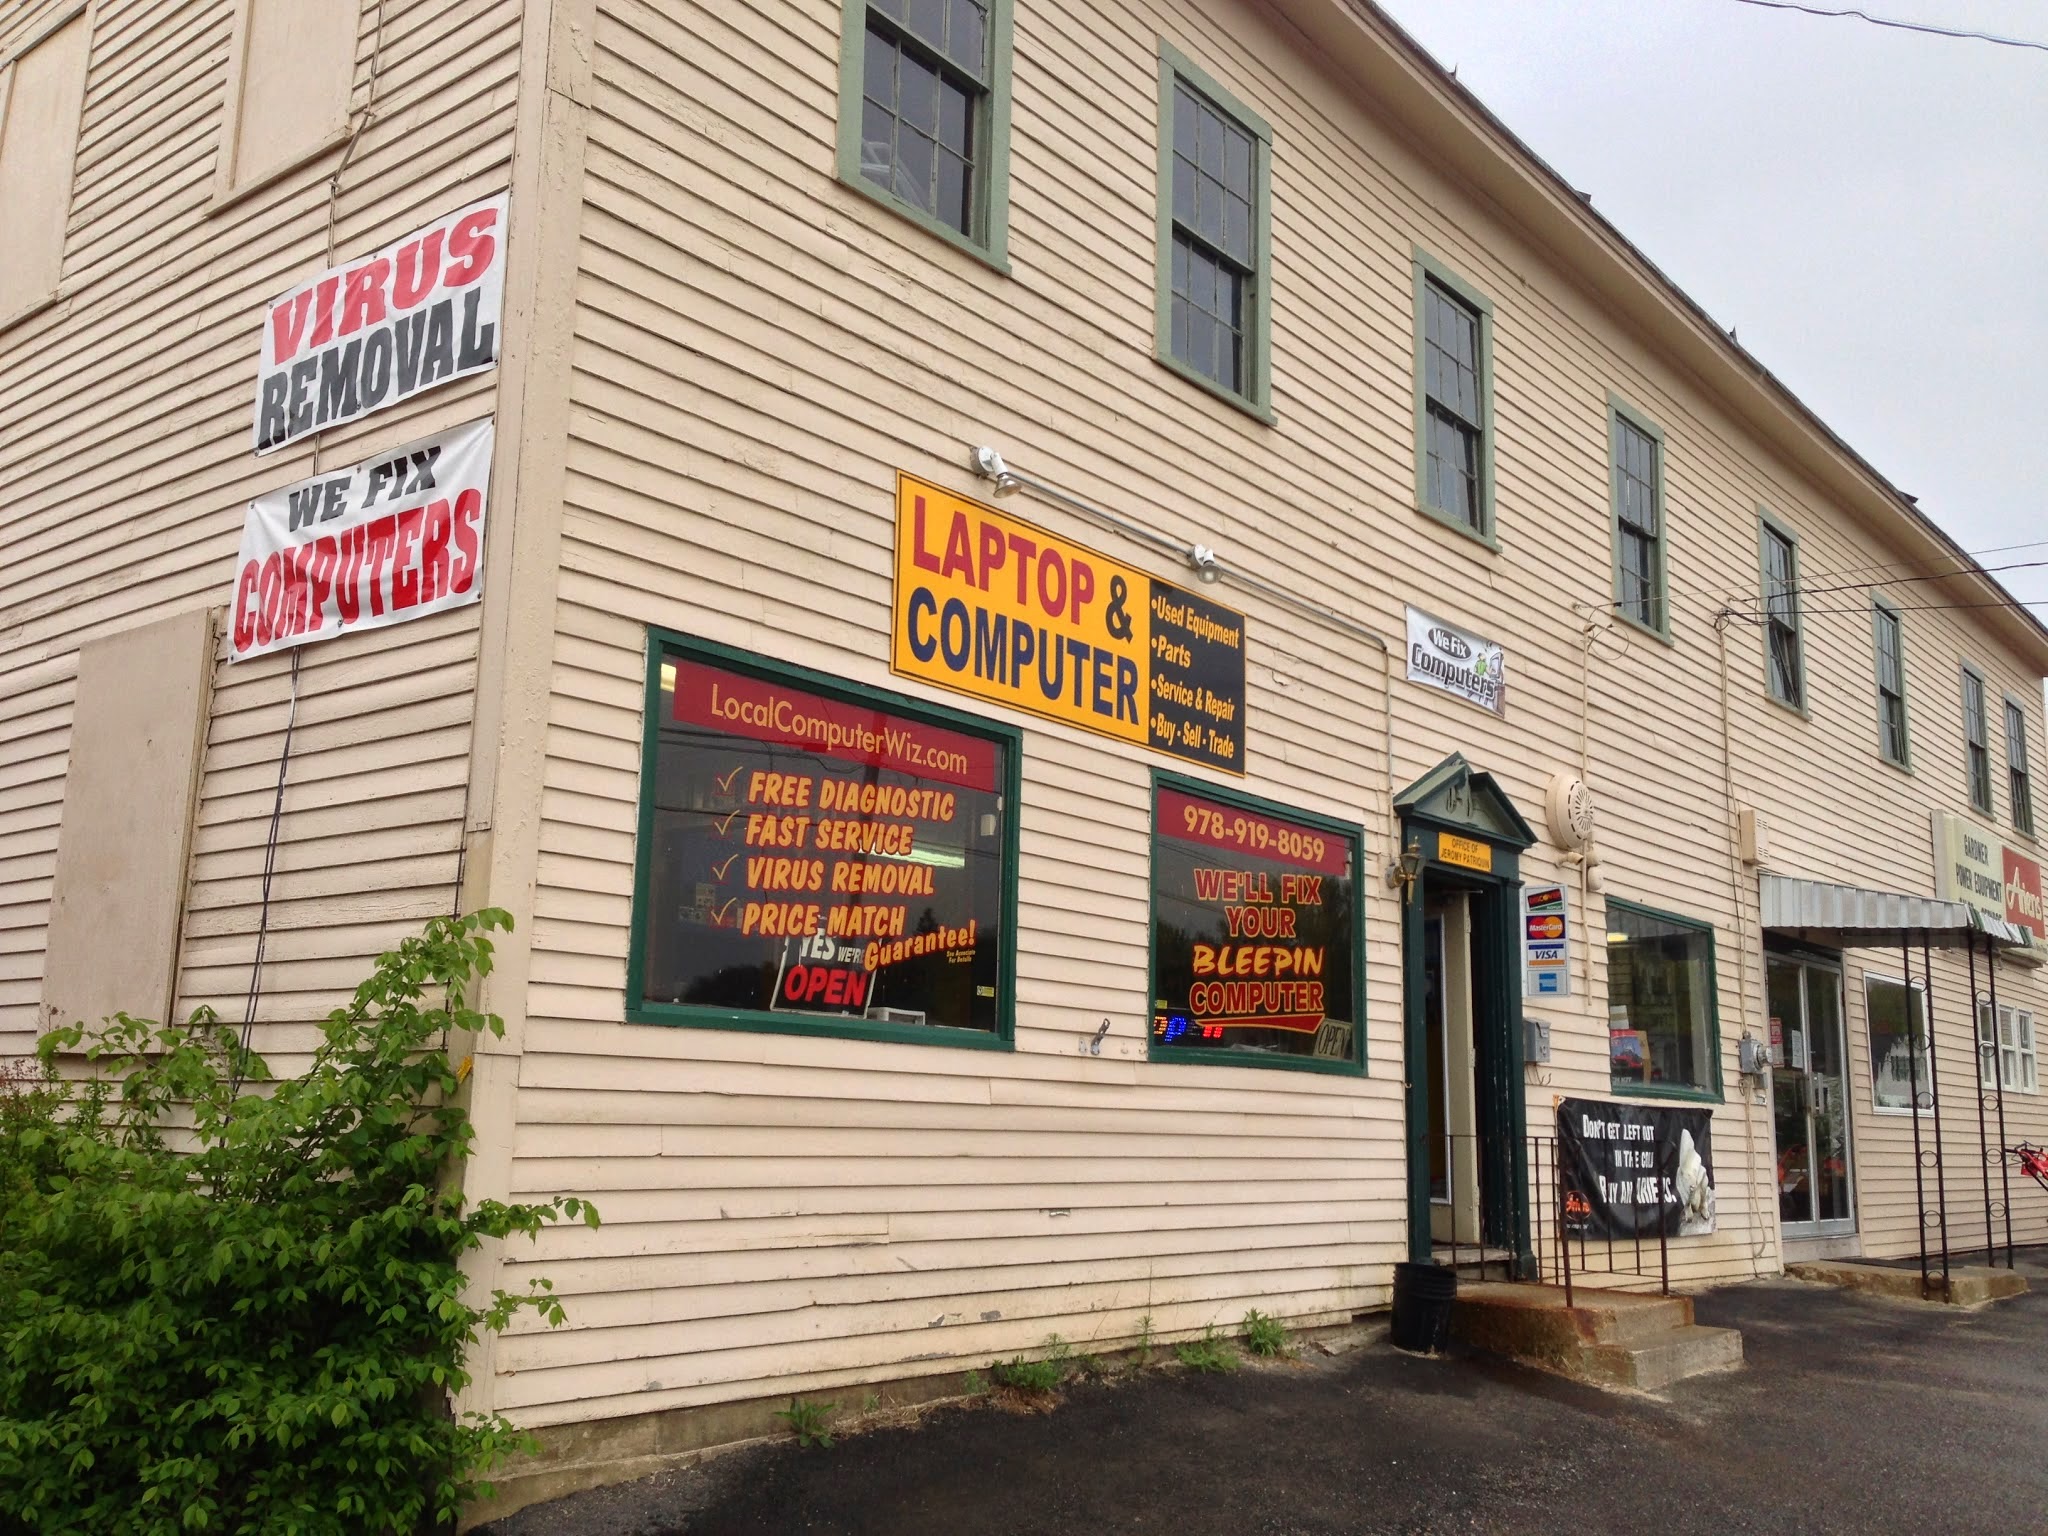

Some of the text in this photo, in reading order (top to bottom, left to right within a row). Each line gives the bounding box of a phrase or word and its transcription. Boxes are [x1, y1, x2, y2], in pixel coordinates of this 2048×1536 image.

[271, 207, 498, 366] VIRUS
[257, 286, 495, 451] REMOVAL
[289, 446, 442, 533] WE FIX
[233, 488, 482, 653] COMPUTERS
[913, 495, 1133, 643] LAPTOP &
[1156, 595, 1240, 649] Used Equipment
[908, 587, 1139, 725] COMPUTER
[1157, 635, 1192, 668] Parts
[1433, 628, 1467, 658] We Fix
[1412, 642, 1495, 698] Computers
[1156, 673, 1235, 722] Service & Repair
[711, 683, 968, 775] LocalComputerWiz.com
[1156, 712, 1176, 746] Buy
[1183, 721, 1201, 749] Sell
[1209, 729, 1235, 759] Trade
[748, 771, 956, 823] FREE DIAGNOSTIC
[744, 814, 915, 855] FAST SERVICE
[1183, 804, 1325, 863] 978-919-8059
[1451, 838, 1479, 853] OFFICE OF
[1964, 834, 1989, 866] GARDNER
[745, 856, 935, 896] VIRUS REMOVAL
[1193, 868, 1322, 905] WE'LL FIX
[1955, 862, 1973, 891] POWER
[742, 901, 819, 937] PRICE
[826, 904, 906, 938] MATCH
[1225, 905, 1297, 939] YOUR
[1529, 923, 1563, 932] MasterCard
[800, 927, 836, 960] YES
[863, 918, 976, 972] Guarantee!
[1192, 944, 1325, 977] BLEEPIN
[1535, 950, 1558, 960] VISA
[784, 964, 868, 1007] OPEN
[1189, 981, 1325, 1015] COMPUTER
[1582, 1114, 1606, 1139] DON'T
[1607, 1122, 1620, 1140] GET
[1623, 1124, 1641, 1140] LEFT
